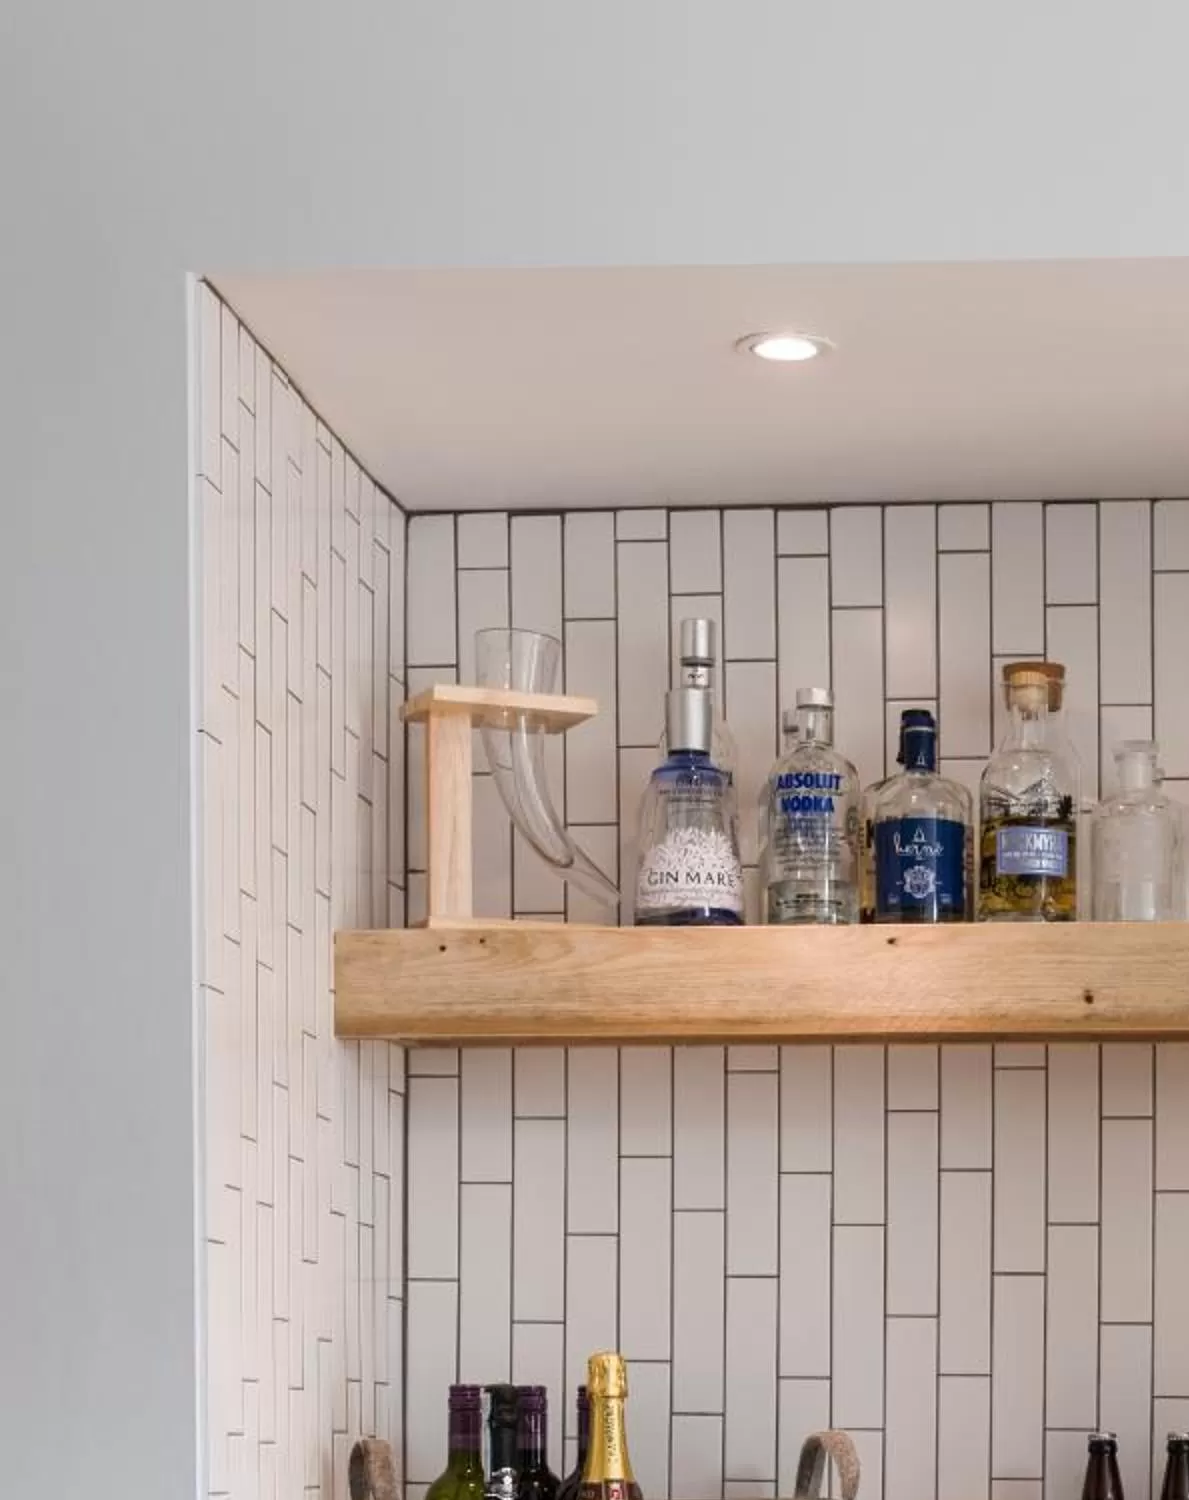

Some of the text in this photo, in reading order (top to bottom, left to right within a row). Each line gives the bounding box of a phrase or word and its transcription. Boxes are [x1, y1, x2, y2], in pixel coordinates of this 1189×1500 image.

[777, 772, 842, 790] ABSOLUT
[781, 796, 834, 812] VODKA
[647, 869, 737, 888] GIN MARE
